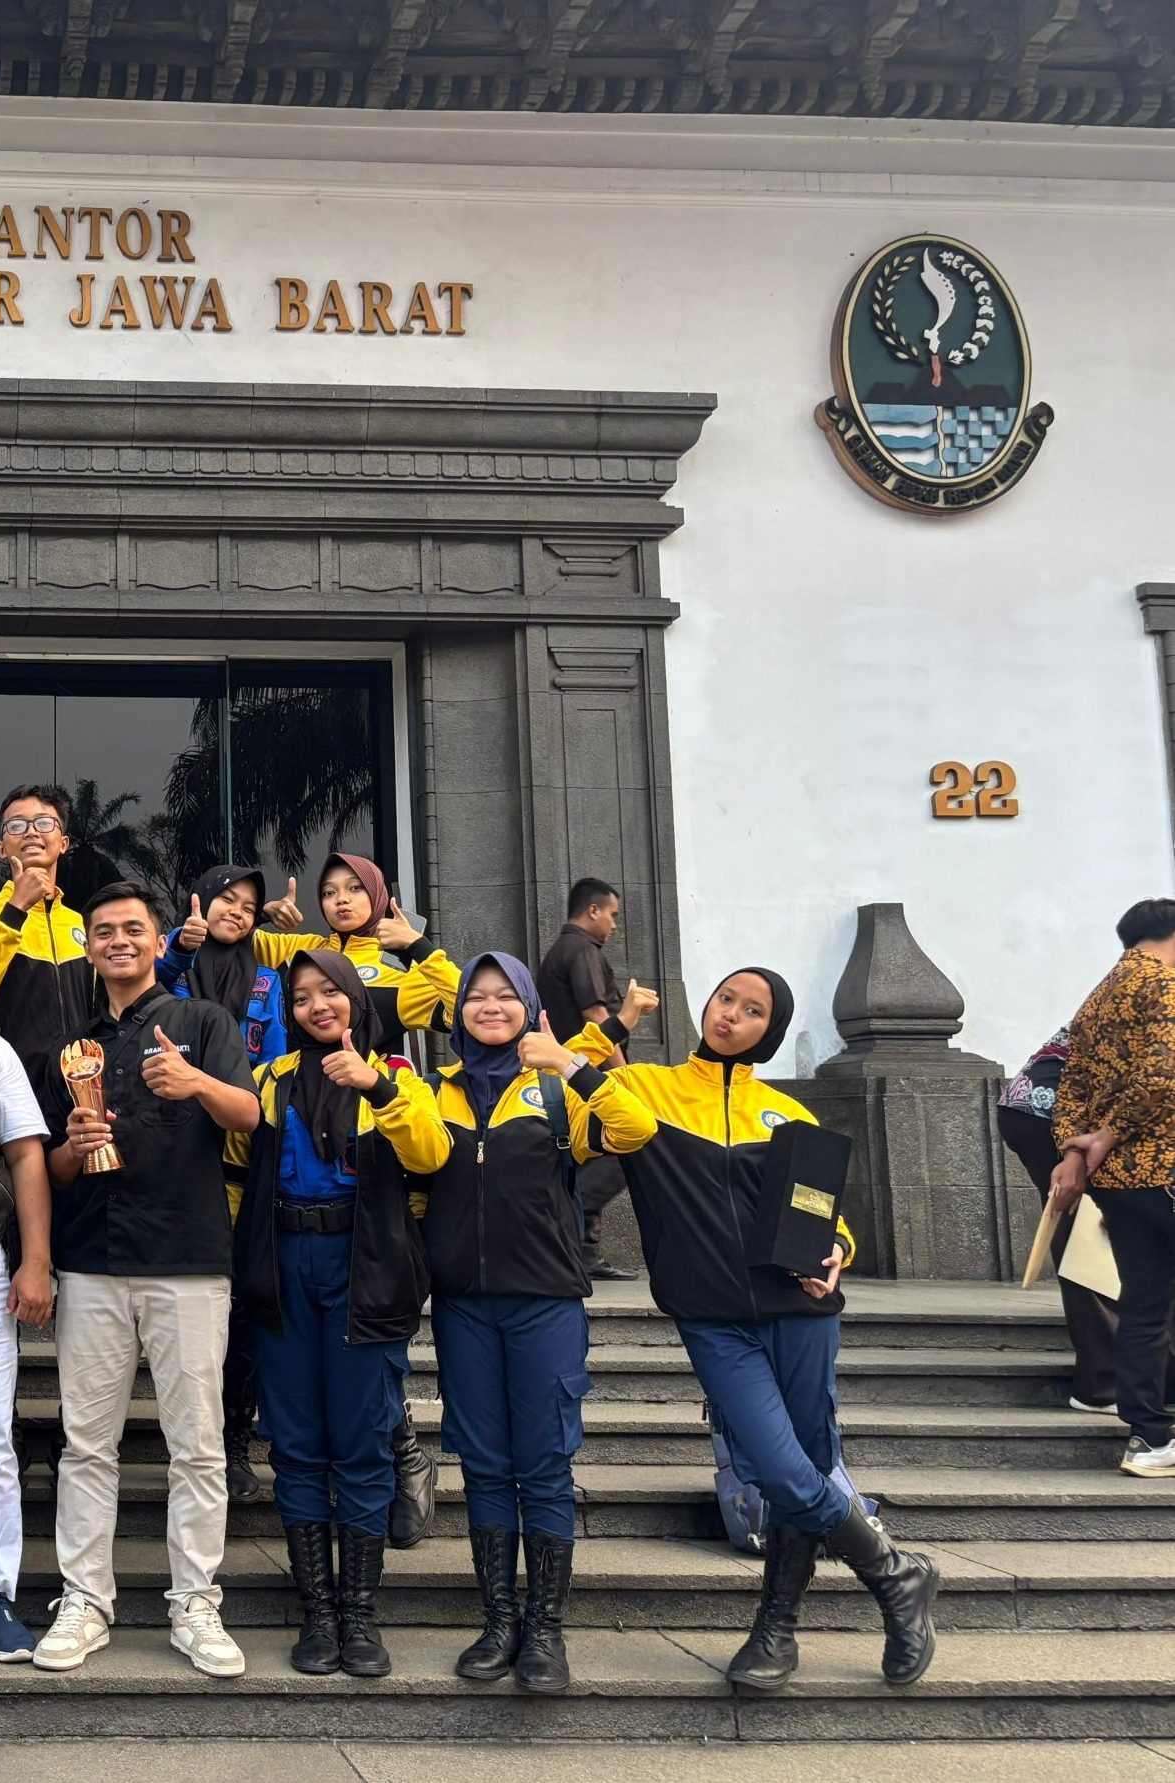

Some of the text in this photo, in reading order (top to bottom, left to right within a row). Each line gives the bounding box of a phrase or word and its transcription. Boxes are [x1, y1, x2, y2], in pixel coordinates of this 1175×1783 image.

[68, 273, 233, 332] JAWA
[275, 276, 474, 336] BARAT
[929, 761, 1019, 818] 22
